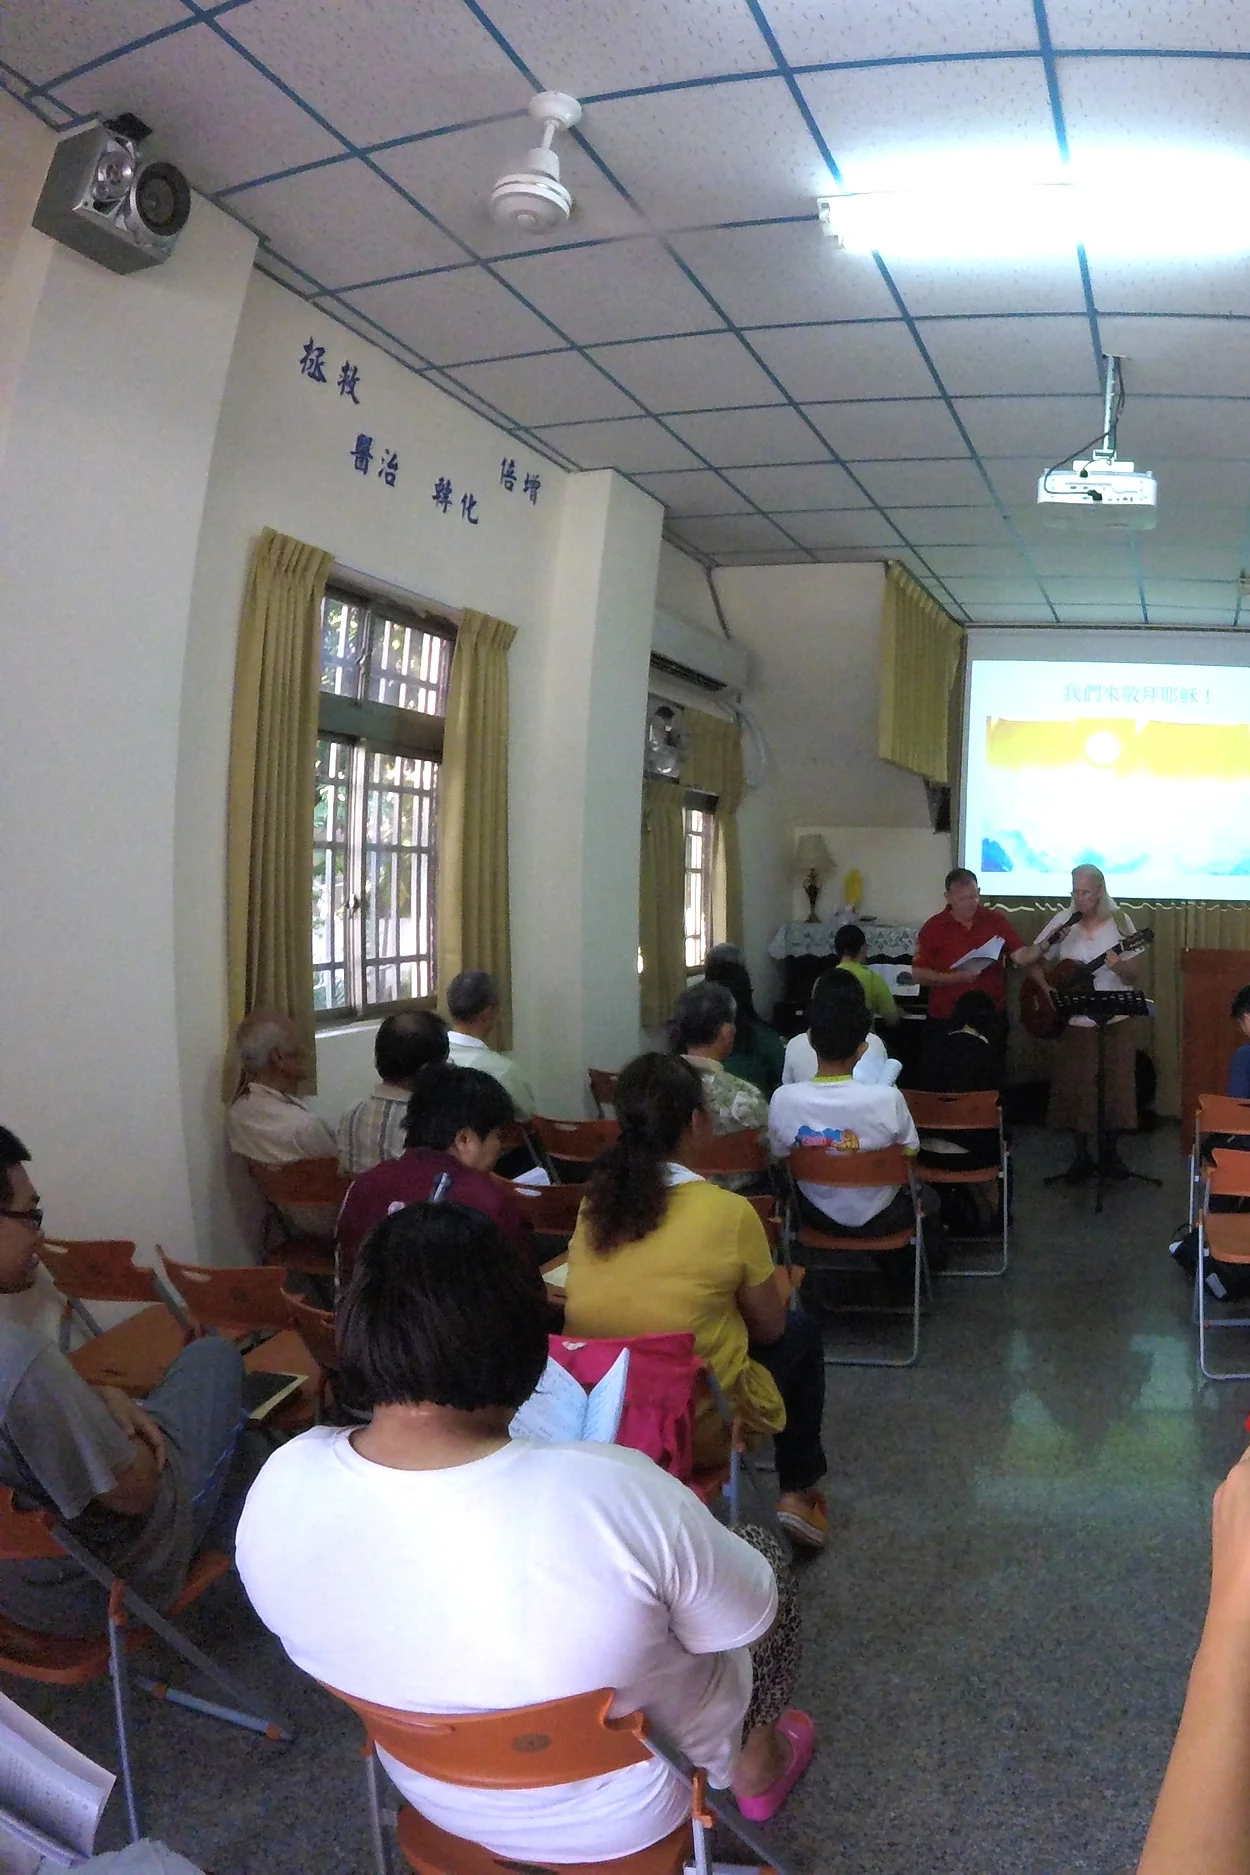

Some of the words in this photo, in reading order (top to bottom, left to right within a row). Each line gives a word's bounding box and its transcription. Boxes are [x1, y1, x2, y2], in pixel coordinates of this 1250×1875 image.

[350, 433, 399, 488] 醫治
[500, 457, 542, 505] 倍增
[432, 476, 479, 525] 轉化
